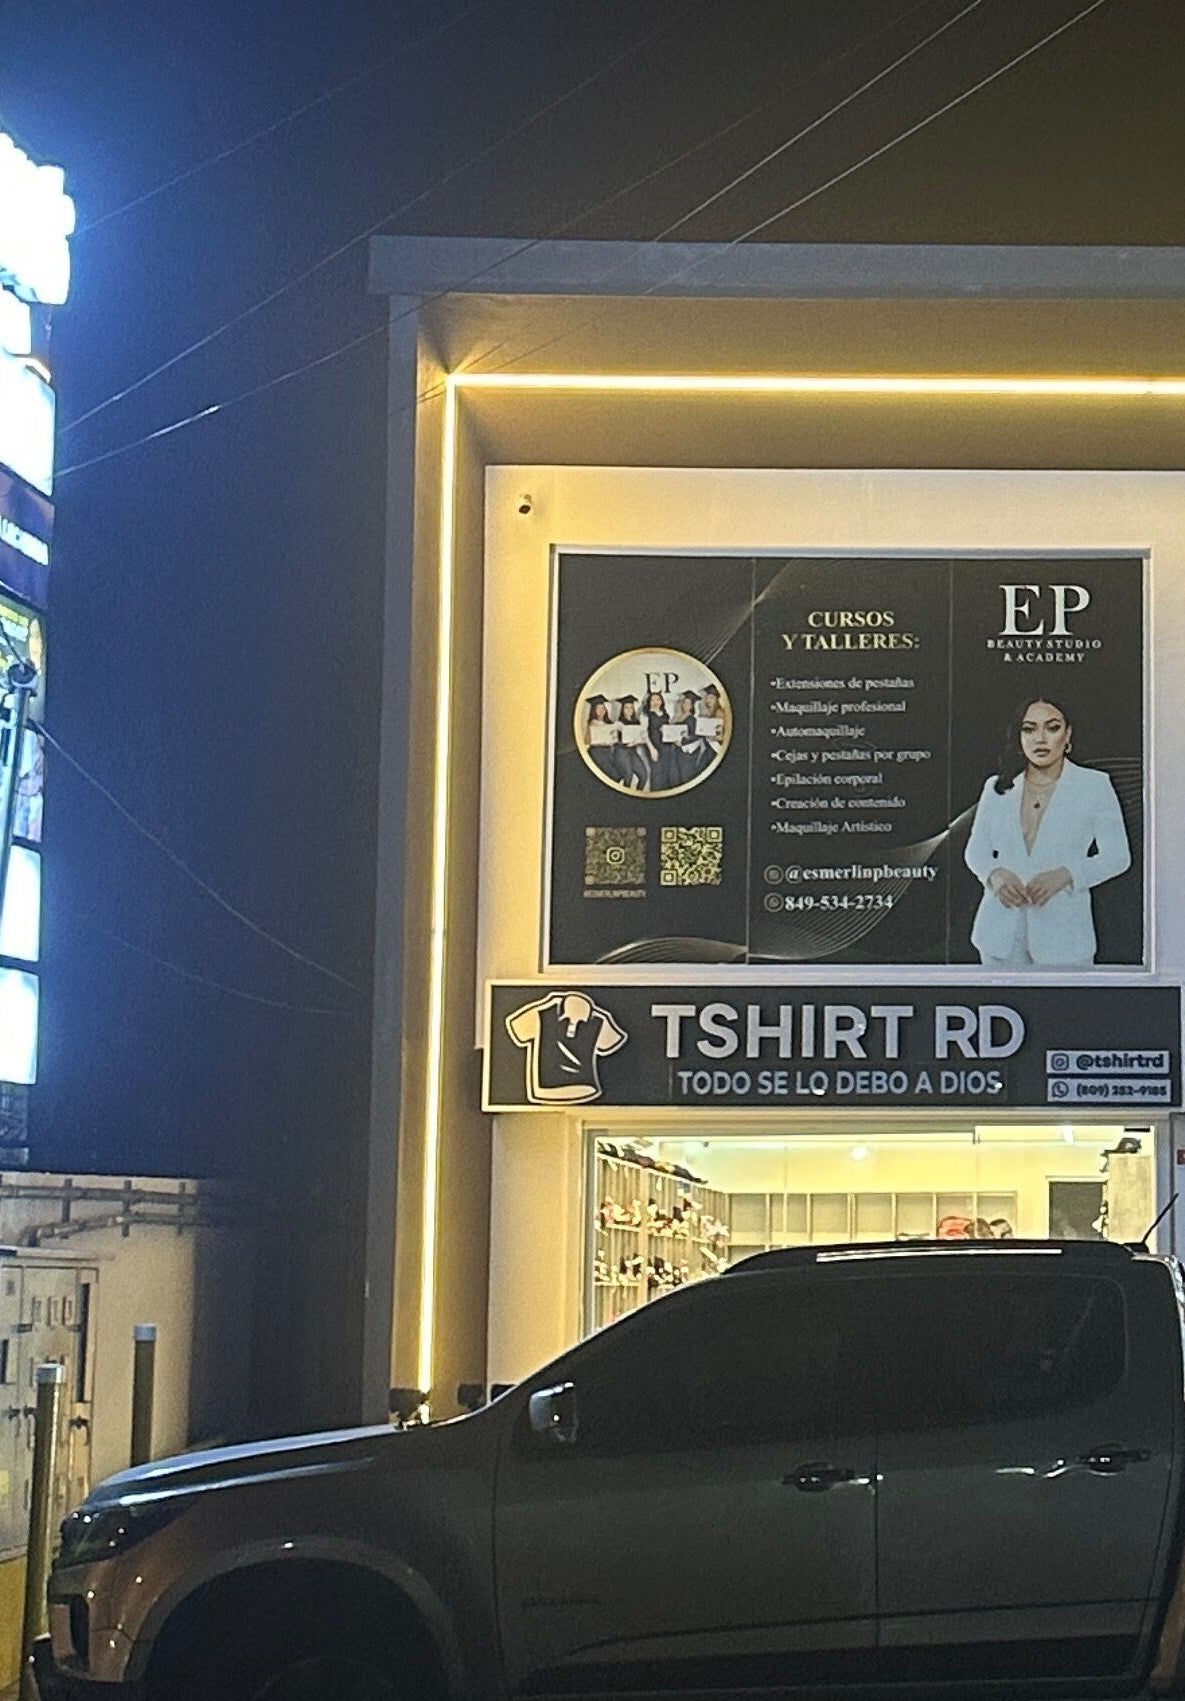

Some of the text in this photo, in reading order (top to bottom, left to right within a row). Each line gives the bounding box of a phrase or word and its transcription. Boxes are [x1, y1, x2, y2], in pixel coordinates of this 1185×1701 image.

[998, 584, 1091, 635] EP
[807, 610, 895, 628] CURSOS
[781, 632, 920, 651] Y TALLERES:
[986, 639, 1102, 649] BEAUTY STUDIO
[1015, 652, 1085, 662] ACADEMY
[643, 672, 679, 694] EP
[847, 676, 863, 689] de
[865, 676, 915, 691] pestañas
[841, 700, 906, 715] profesional
[811, 752, 820, 764] y
[822, 749, 871, 763] pestañas
[874, 751, 894, 763] por
[896, 751, 932, 763] grupo
[834, 772, 883, 786] corporal
[831, 797, 846, 809] de
[848, 796, 906, 808] contenido
[785, 864, 938, 884] @esmerlinpbeauty
[784, 894, 894, 911] 849-534-2734
[651, 1003, 1025, 1059] TSHIRT RD
[1076, 1053, 1164, 1070] @tshirtrd
[677, 1070, 1001, 1095] TODO SE LO DEBO A DIOS
[1076, 1083, 1109, 1098] (809)
